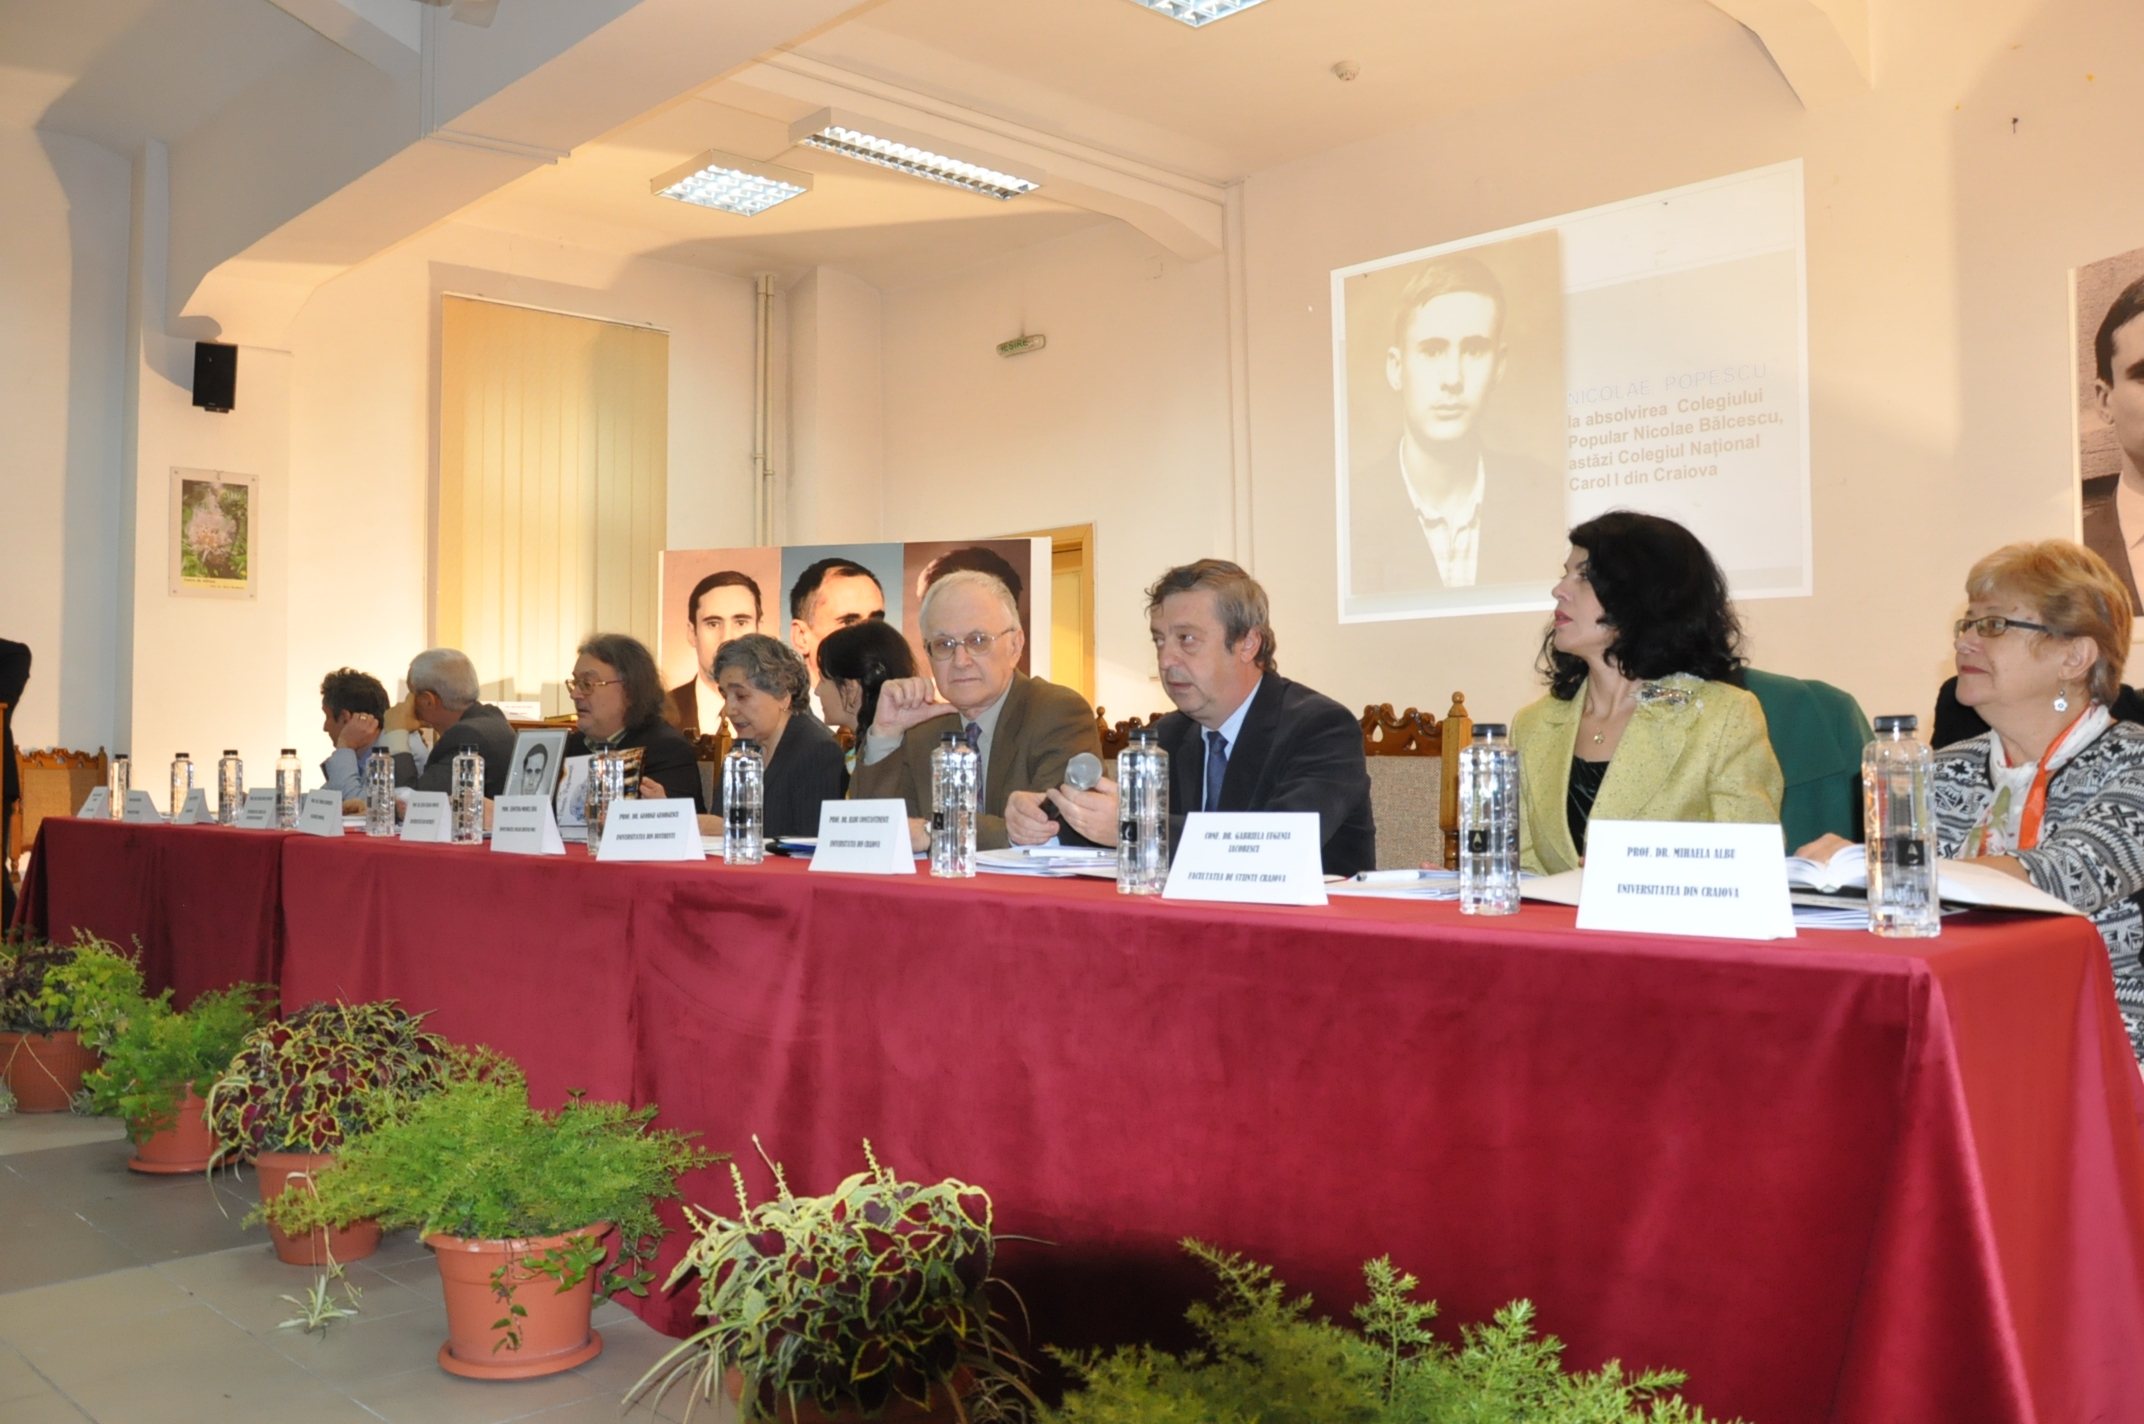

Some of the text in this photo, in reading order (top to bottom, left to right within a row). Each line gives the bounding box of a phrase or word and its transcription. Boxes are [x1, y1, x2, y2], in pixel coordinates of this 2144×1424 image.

[1567, 379, 1651, 406] NICOLAE
[1567, 388, 1763, 428] la absolvirea Colegiului
[1568, 411, 1784, 450] Popular Nicolae Bălcescu,
[1568, 451, 1613, 470] astăzi
[1618, 443, 1684, 464] Colegiul
[1569, 463, 1718, 491] Carol I din Craiova
[1626, 847, 1736, 860] PROF. DR. MIHAELA ALBU
[1617, 883, 1739, 898] UNIVERSITATEA DIN CRAIOVA
